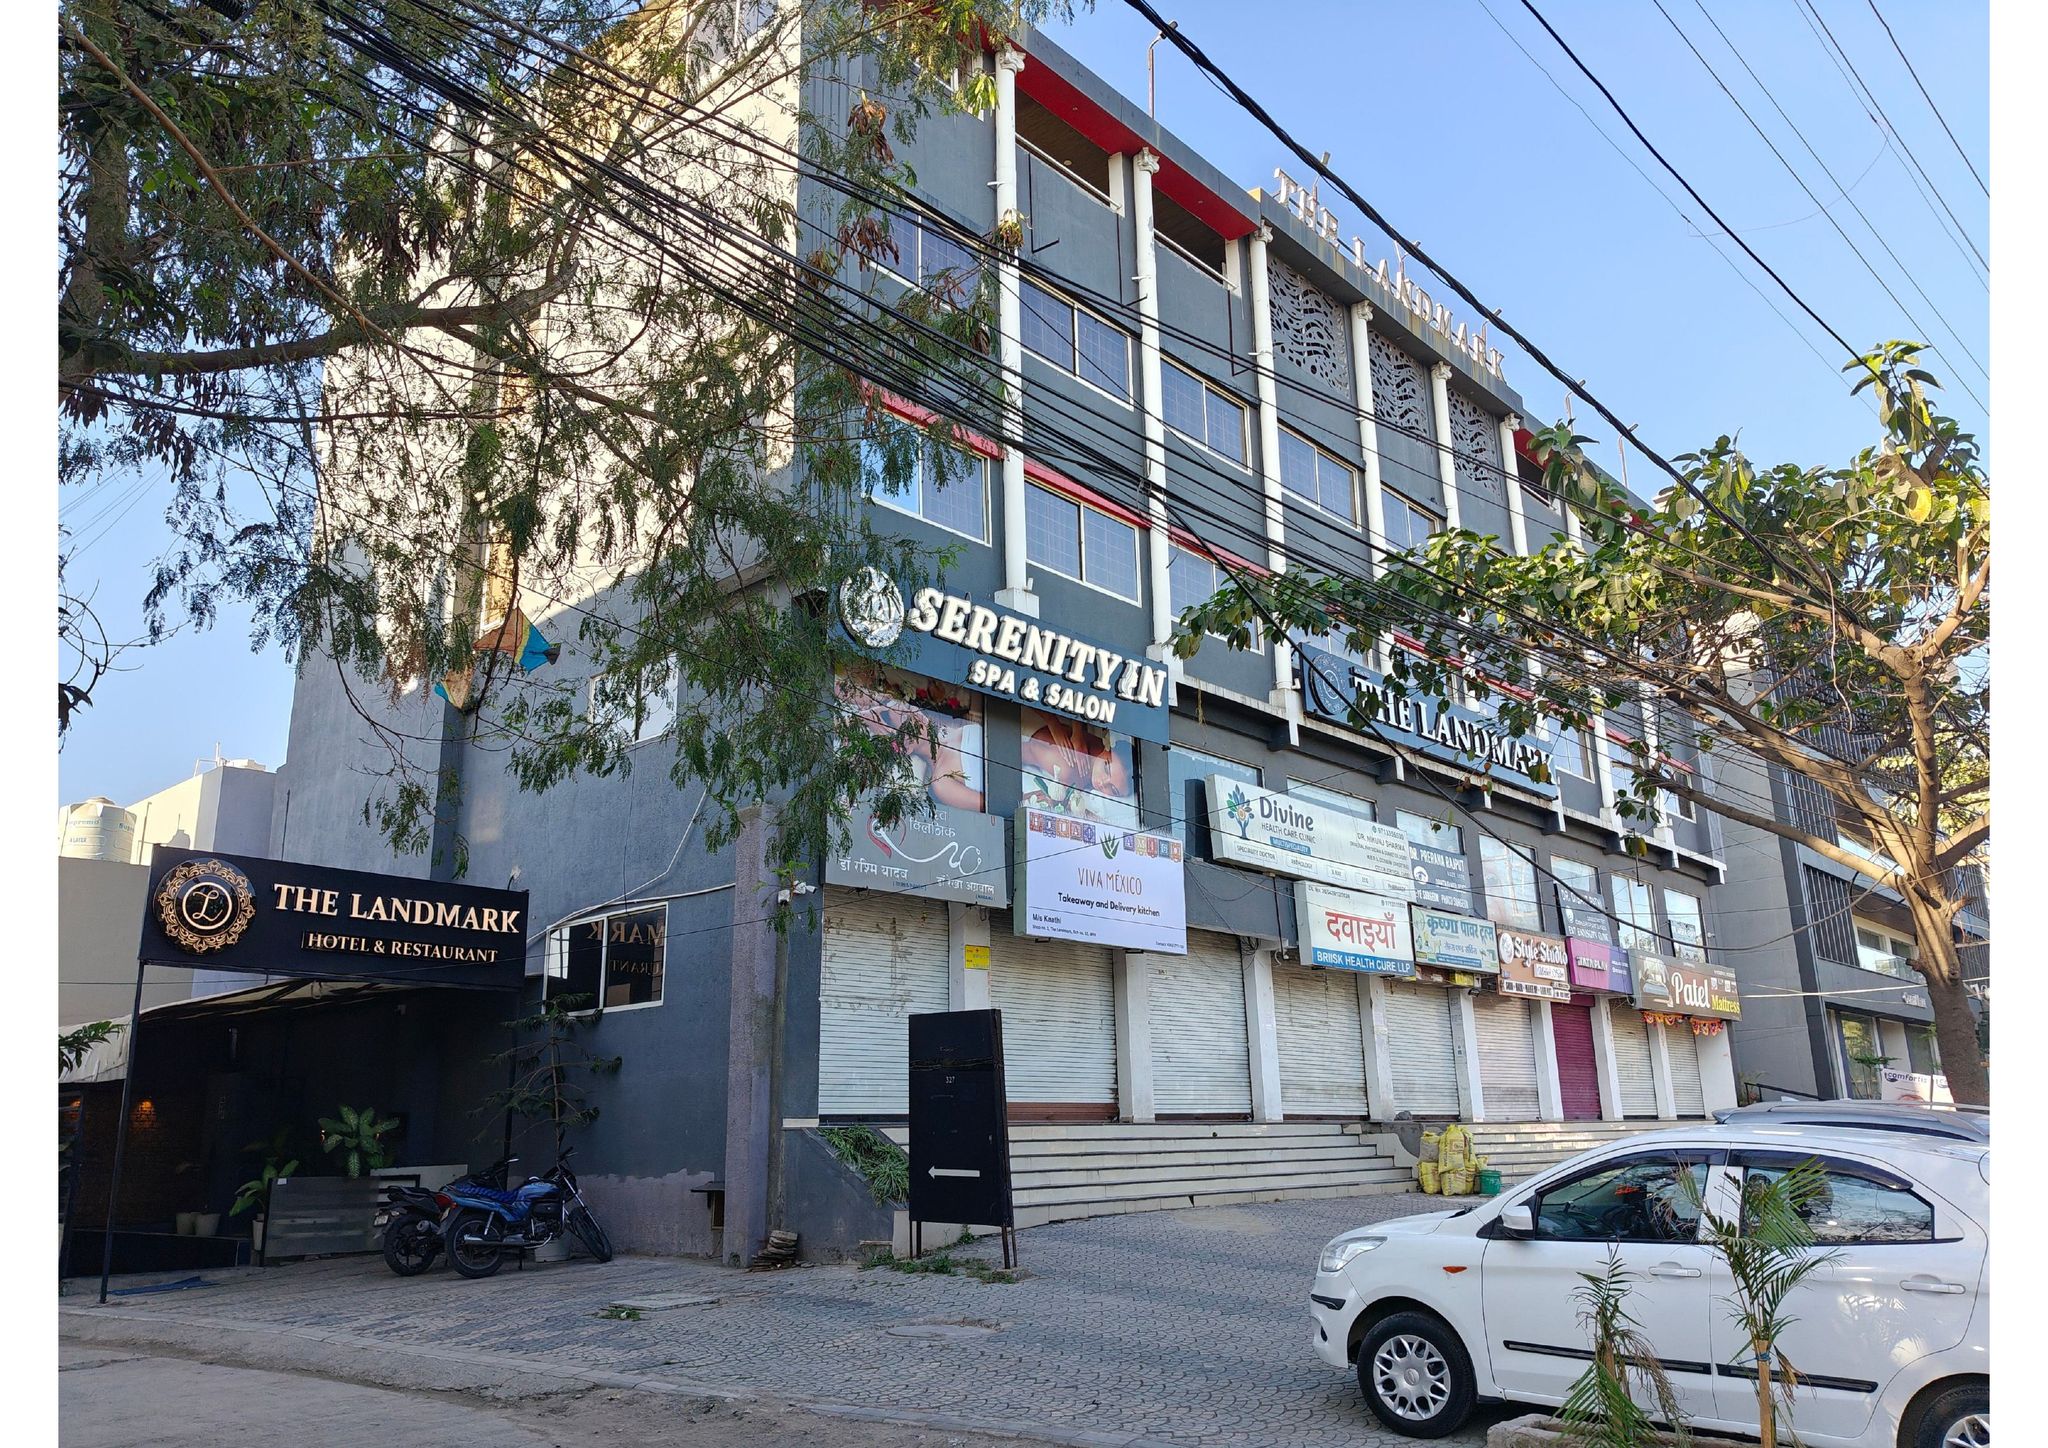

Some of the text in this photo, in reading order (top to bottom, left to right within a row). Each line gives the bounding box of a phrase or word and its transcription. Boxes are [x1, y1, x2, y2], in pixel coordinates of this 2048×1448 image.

[1273, 167, 1507, 385] THE LANDMARK
[969, 659, 1117, 724] SPA & SALON
[1259, 796, 1314, 832] Divine
[1261, 822, 1316, 844] HEALTH CARE CLINIC
[880, 864, 909, 880] यादव
[1078, 867, 1142, 896] VIVA MÉXICO
[273, 883, 521, 934] THE LANDMARK
[1058, 892, 1161, 917] Takeaway and Delivery kitchen
[1325, 911, 1397, 953] दवाइयाँ
[1459, 920, 1479, 938] पावर
[308, 932, 499, 963] HOTEL & RESTAURANT
[1317, 951, 1411, 973] BRIISK HEALTH CURE LLP
[1514, 936, 1539, 968] Style
[1539, 940, 1568, 965] Studio
[1671, 971, 1711, 1009] Patel
[1711, 994, 1741, 1014] Mattress
